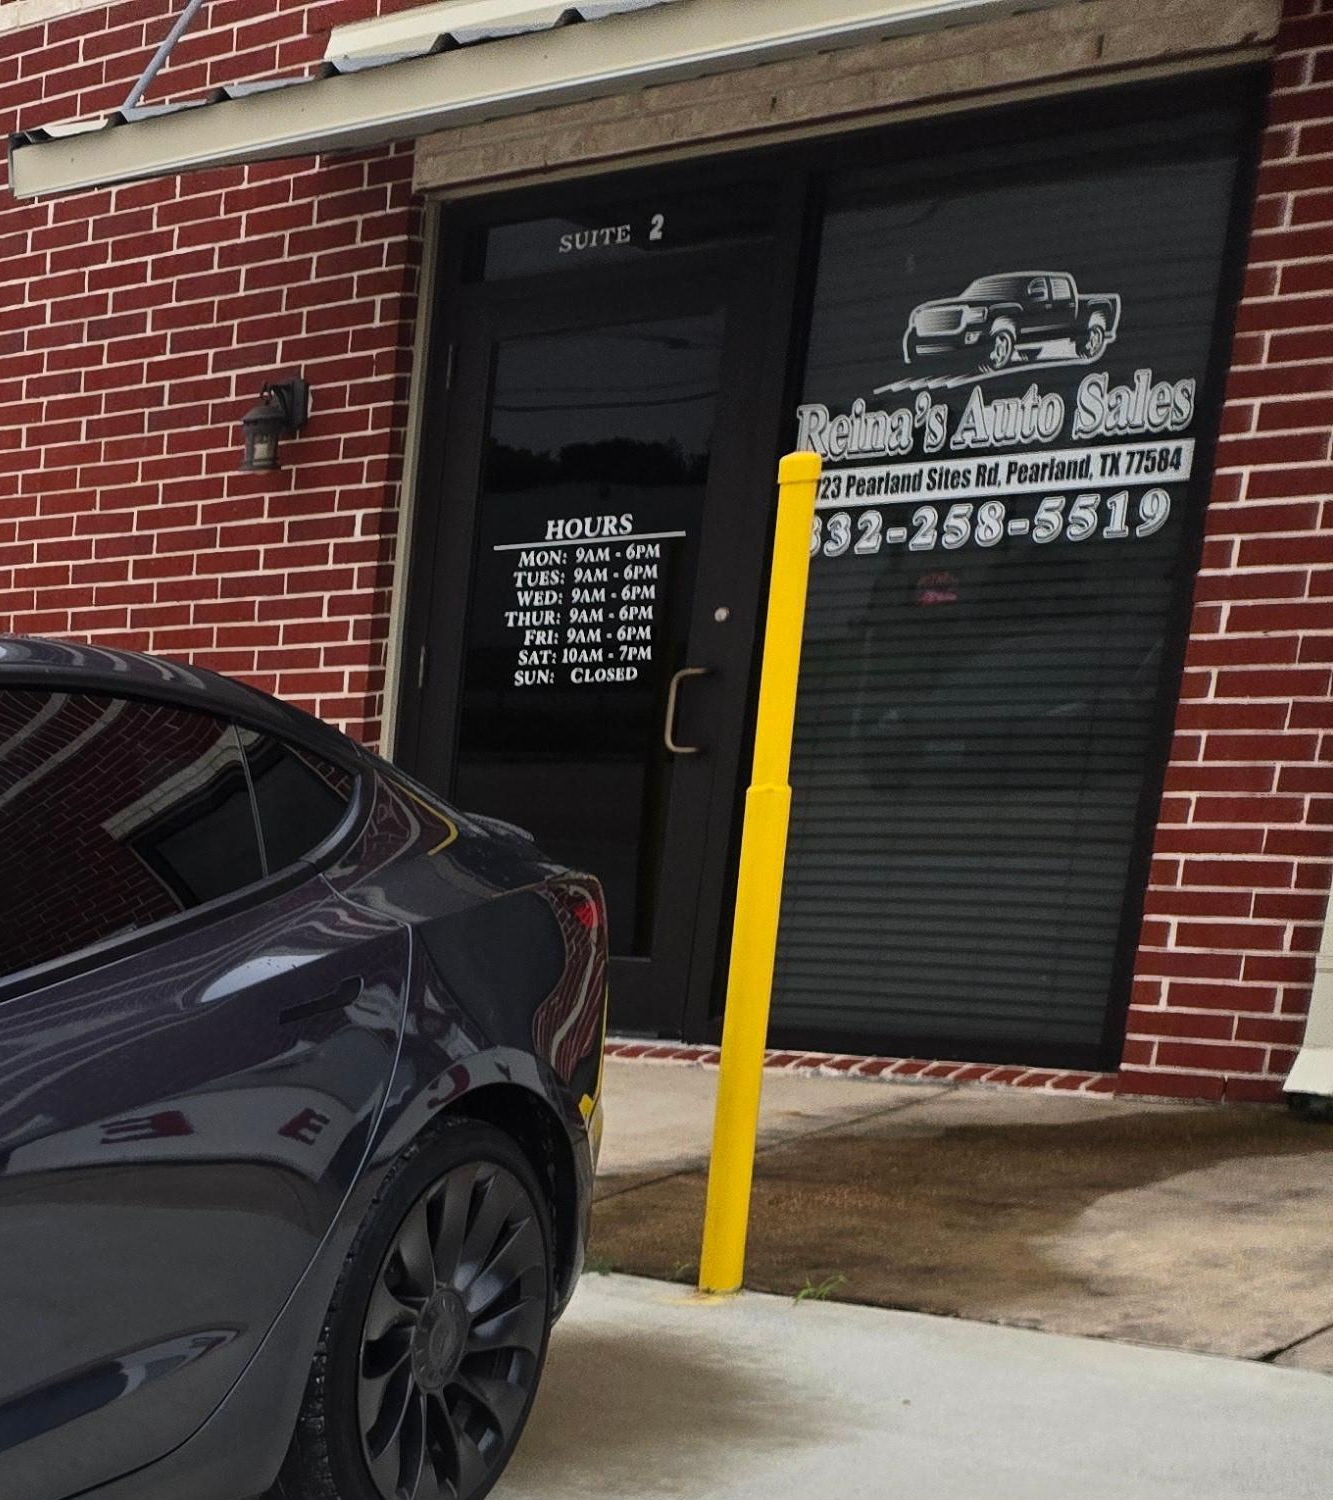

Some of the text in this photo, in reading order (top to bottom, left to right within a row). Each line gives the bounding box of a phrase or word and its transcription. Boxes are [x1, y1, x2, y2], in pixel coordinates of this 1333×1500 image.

[559, 213, 665, 253] SUITE 2
[796, 369, 1195, 463] Reina's Auto Sales
[845, 469, 923, 498] Pearland
[926, 466, 971, 492] Sites
[1006, 453, 1094, 485] Pearland,
[1100, 452, 1121, 477] TX
[1125, 446, 1183, 475] 77584
[545, 513, 633, 540] HOURS
[517, 550, 568, 568] MON:
[575, 547, 611, 564] 9AM
[625, 542, 661, 561] 6PM
[513, 569, 566, 588] TUES:
[573, 567, 609, 584] 9AM
[623, 563, 659, 581] 6PM
[516, 589, 564, 607] WED:
[570, 587, 606, 604] 9AM
[620, 583, 656, 601] 6PM
[504, 610, 561, 628] THUR:
[568, 607, 604, 624] 9AM
[618, 604, 654, 621] 6PM
[523, 628, 559, 646] FRI:
[566, 627, 602, 644] 9AM
[616, 624, 652, 642] 6PM
[517, 650, 557, 666] SAT:
[561, 647, 604, 664] 10AM
[618, 644, 653, 662] 7PM
[513, 666, 639, 687] SUN: CLOSED
